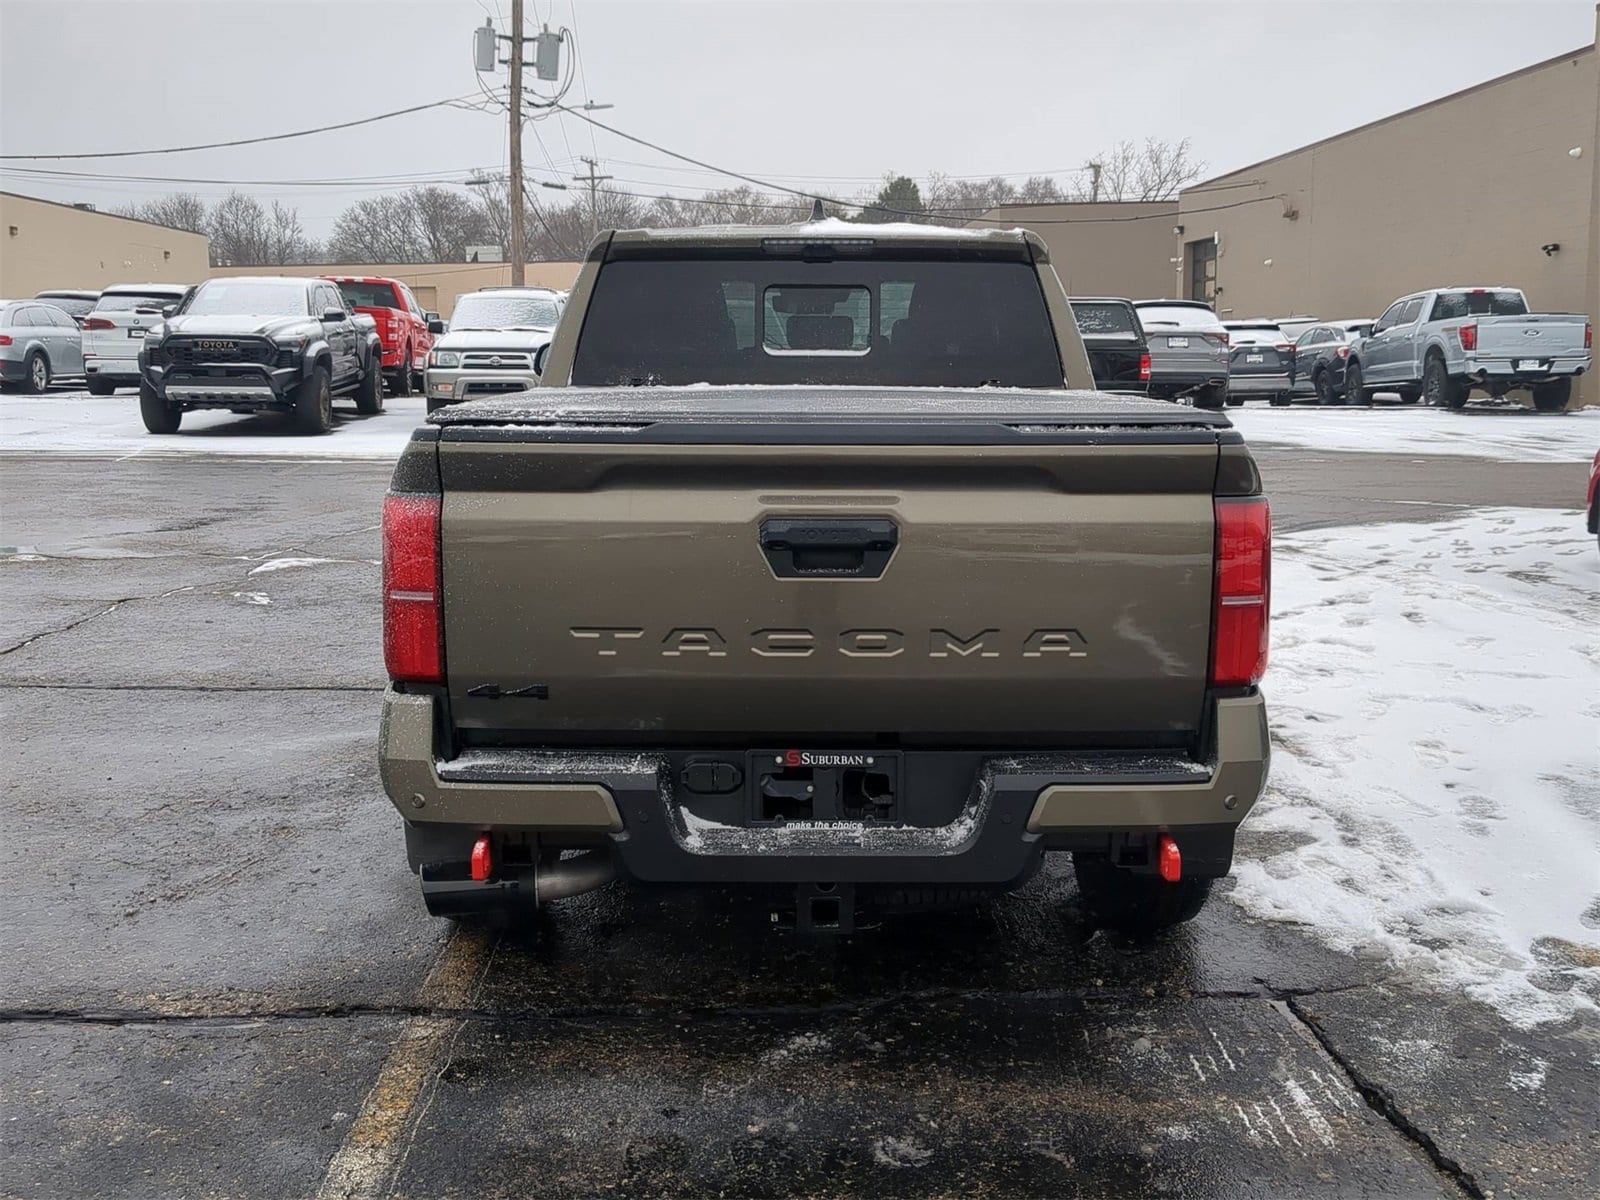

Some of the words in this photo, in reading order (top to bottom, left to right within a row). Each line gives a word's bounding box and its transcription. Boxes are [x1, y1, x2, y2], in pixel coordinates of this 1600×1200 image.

[569, 626, 1088, 658] TACOMA
[786, 821, 812, 830] make
[814, 821, 830, 830] the
[832, 821, 864, 830] choice
